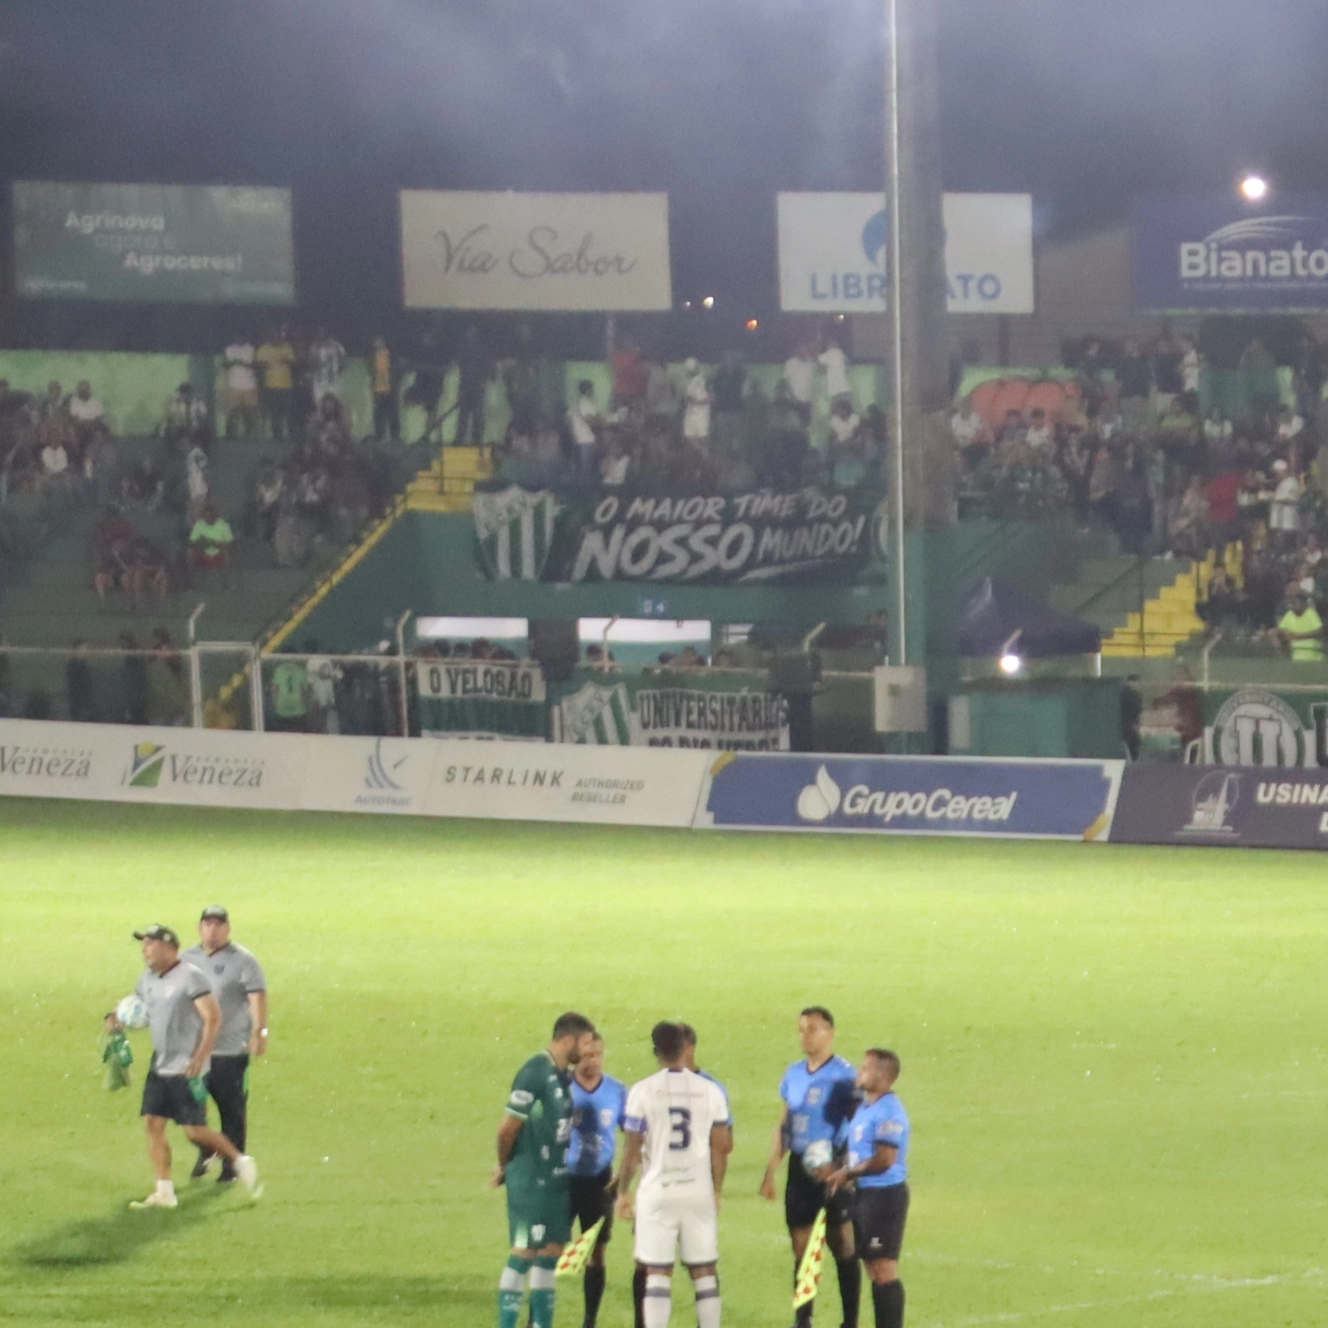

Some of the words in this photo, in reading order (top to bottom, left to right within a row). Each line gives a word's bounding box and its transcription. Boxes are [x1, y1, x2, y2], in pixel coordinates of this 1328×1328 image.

[65, 209, 165, 235] Agrinova
[432, 223, 500, 275] Via
[508, 225, 638, 279] Sabor
[593, 496, 619, 523] O
[626, 496, 726, 521] MAIOR
[733, 493, 797, 519] TIME
[571, 522, 755, 580] NOSSO
[758, 514, 866, 562] MUNDO!
[0, 746, 91, 778] Veneza
[170, 754, 263, 787] Veneza
[445, 765, 564, 787] STARLINK
[843, 784, 1018, 823] GrupoCereal
[668, 1106, 691, 1150] 3
